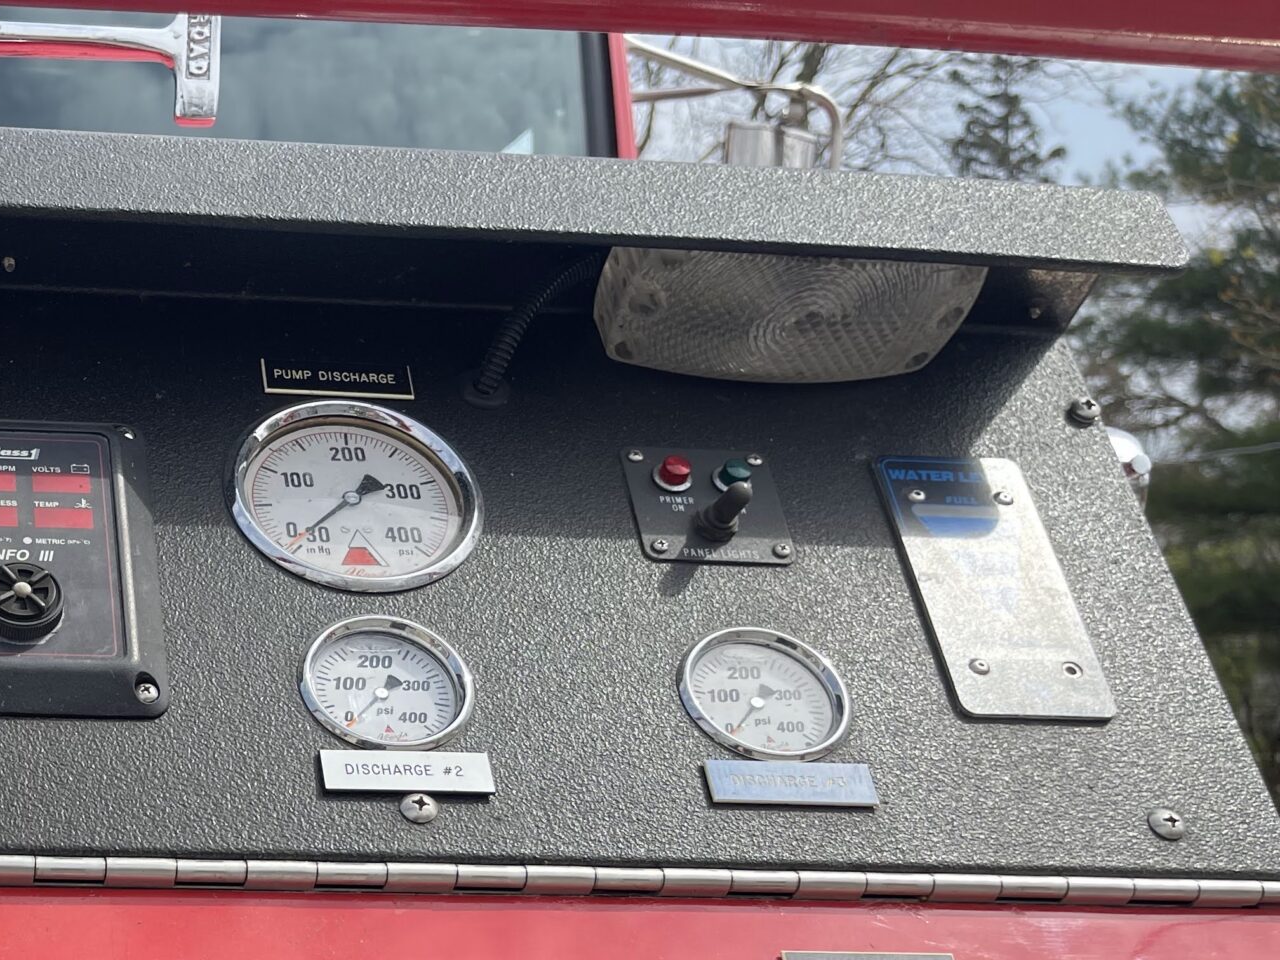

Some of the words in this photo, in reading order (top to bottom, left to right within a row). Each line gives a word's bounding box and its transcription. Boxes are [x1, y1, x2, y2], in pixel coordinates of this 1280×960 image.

[273, 368, 312, 380] PUMP
[318, 371, 396, 385] DISCHARGE
[329, 446, 366, 462] 200
[32, 465, 61, 474] VOLTS
[888, 468, 954, 481] WATER
[280, 471, 314, 488] 100
[385, 483, 421, 500] 300
[659, 495, 695, 505] PRIMER
[672, 503, 686, 512] ON
[385, 527, 422, 543] 400
[720, 549, 760, 560] LIGHTS
[357, 655, 393, 669] 200
[727, 666, 761, 680] 200
[333, 676, 367, 691] 100
[402, 680, 431, 692] 300
[707, 688, 740, 703] 100
[774, 688, 801, 701] 300
[376, 705, 394, 716] psi
[398, 711, 428, 724] 400
[776, 721, 805, 733] 400
[344, 763, 434, 777] DISCHARGE
[442, 765, 464, 778] #2
